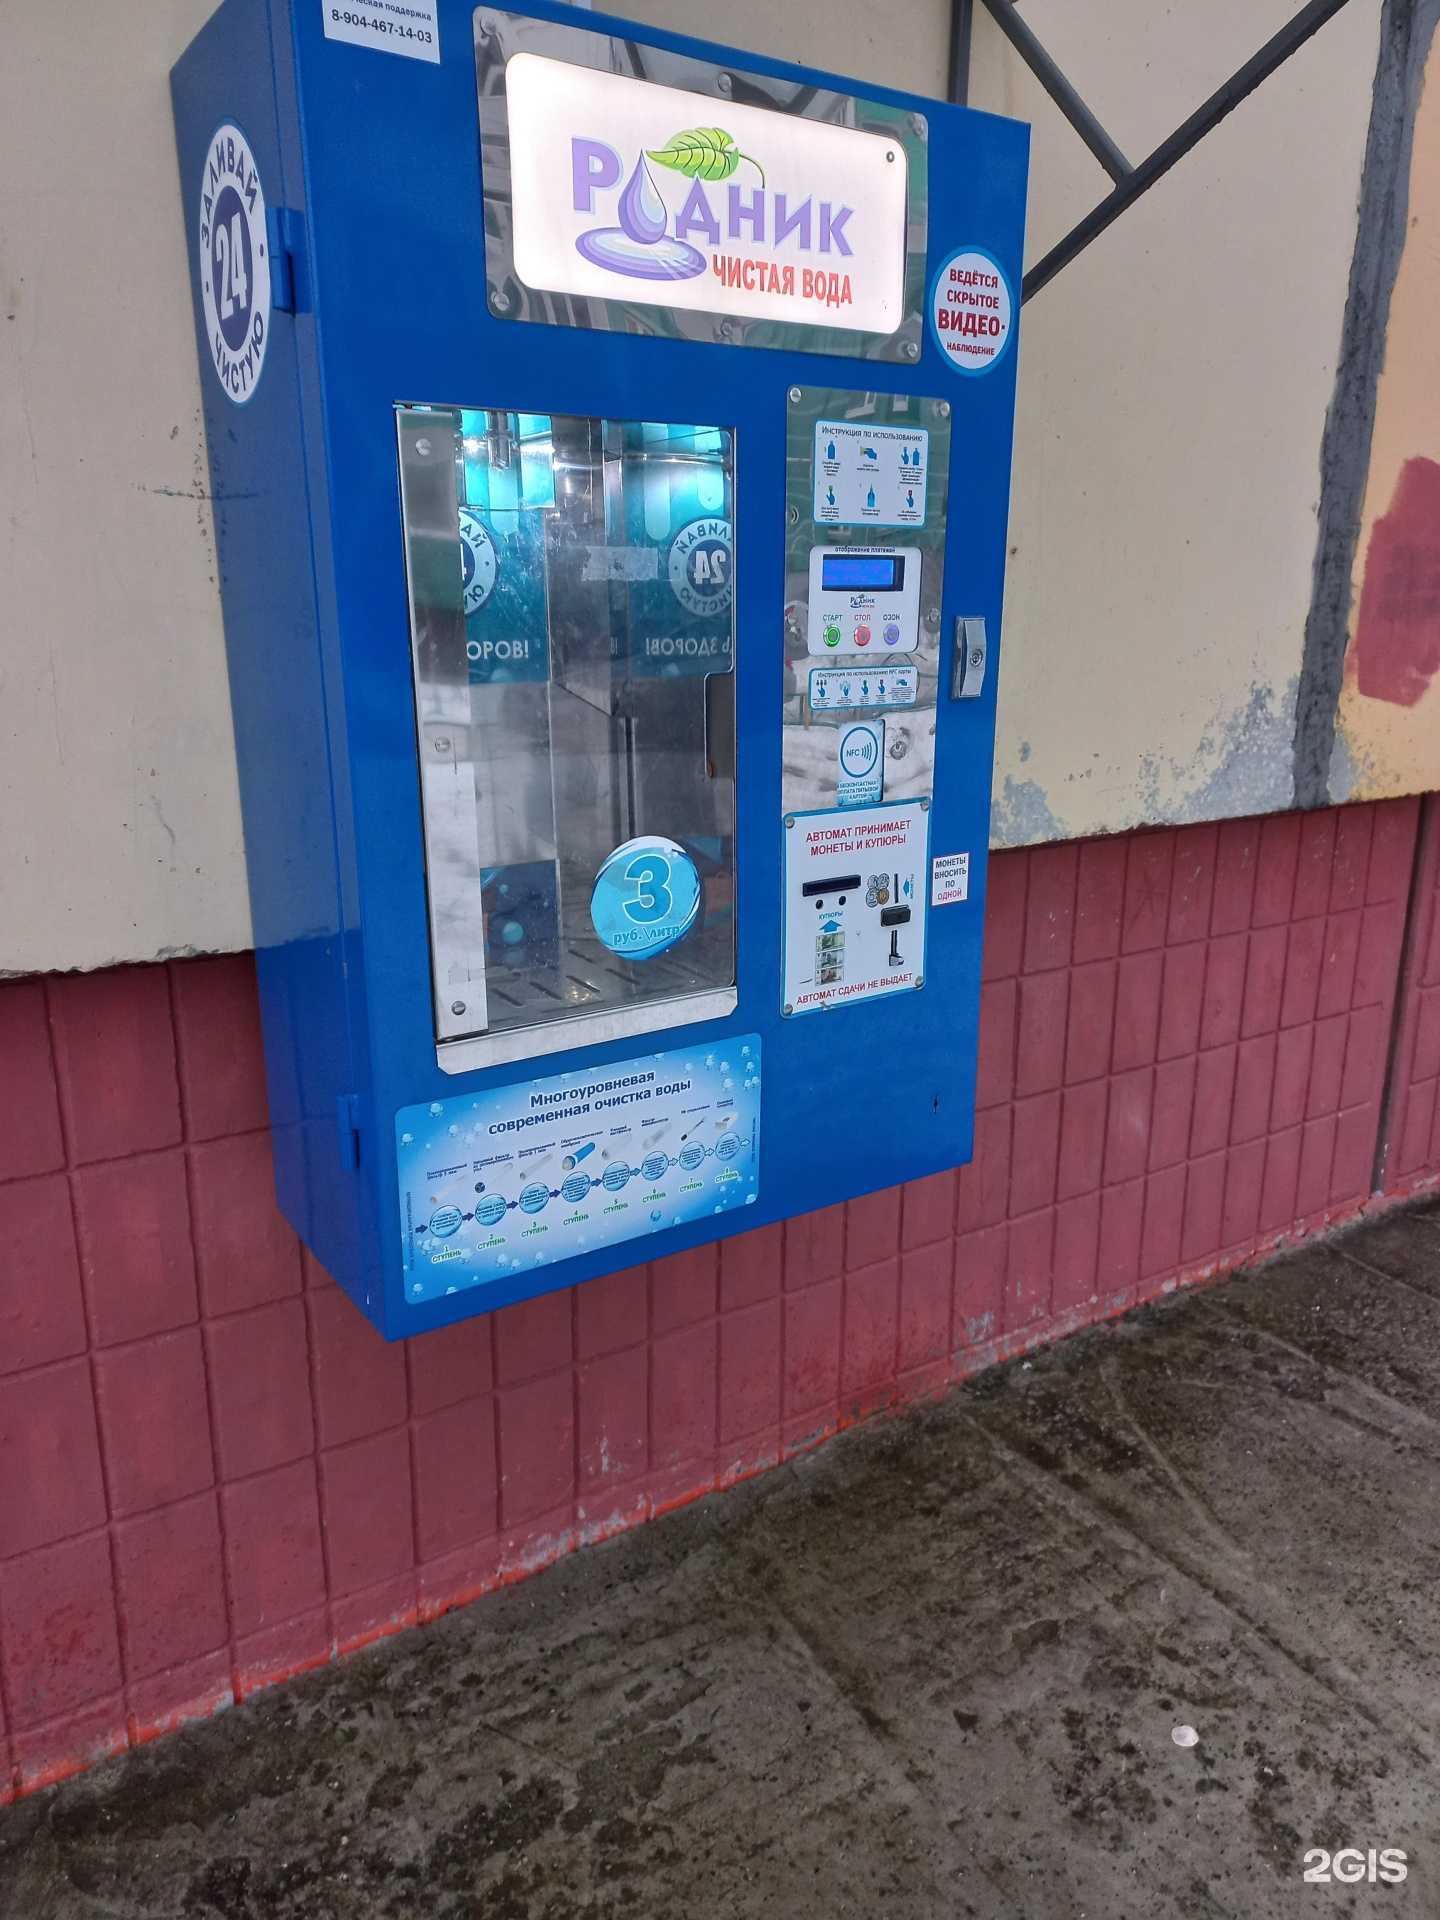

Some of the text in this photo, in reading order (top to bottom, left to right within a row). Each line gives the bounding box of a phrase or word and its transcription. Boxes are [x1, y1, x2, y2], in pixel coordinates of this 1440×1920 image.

[331, 9, 433, 43] 8-904-467-14-03
[201, 136, 258, 249] ЗАЛИВАЙ
[215, 212, 247, 320] 24
[711, 254, 853, 307] ЧИСТАЯ ВОДА
[949, 268, 999, 289] ВЕДЁТСЯ
[946, 289, 1000, 309] СКРЫТОЕ
[215, 311, 264, 394] ЧИСТУЮ
[946, 341, 996, 357] НАБЛЮДЕНИЕ
[846, 748, 860, 757] NFC
[806, 820, 911, 842] АВТОМАТ ПРИНИМАЕТ
[810, 835, 906, 856] МОНЕТЫ И КУПЮРЫ
[934, 868, 967, 880] ВНОСИТЬ
[935, 857, 966, 869] МОНЕТЫ
[622, 854, 673, 924] 3
[937, 889, 962, 900] ОДНОЙ
[945, 880, 955, 889] ПО
[796, 973, 912, 1005] АВТОМАТ СДАЧИ НЕ ВЫДАЕТ
[530, 1071, 655, 1108] Многоуровневая
[489, 1100, 590, 1135] современная
[594, 1088, 651, 1112] очистка
[655, 1079, 691, 1099] воды
